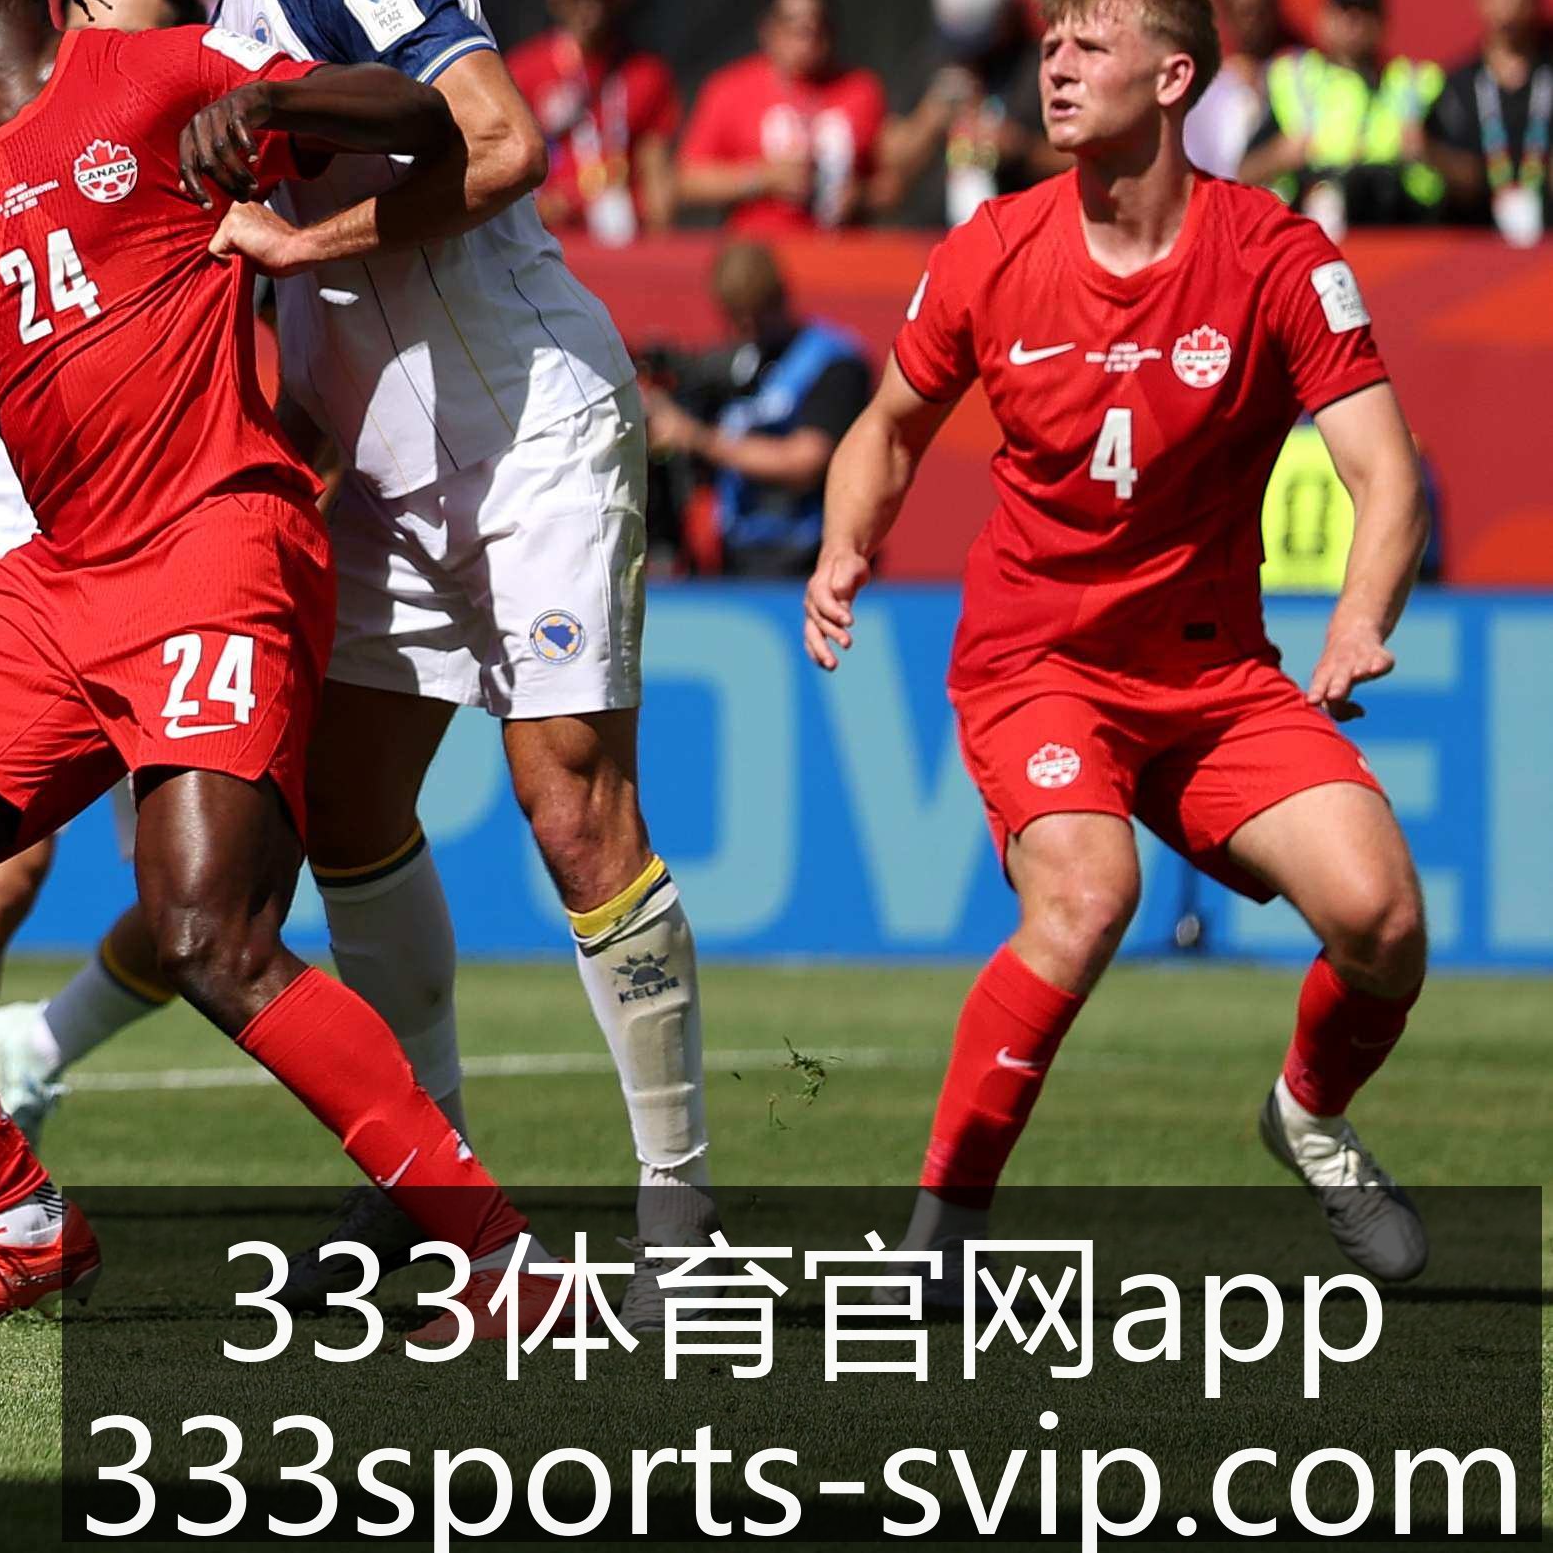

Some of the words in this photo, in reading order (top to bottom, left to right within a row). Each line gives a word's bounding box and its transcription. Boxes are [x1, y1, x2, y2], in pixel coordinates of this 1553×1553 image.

[77, 161, 135, 183] CANADA
[1090, 407, 1139, 500] 4
[160, 632, 256, 725] 24
[618, 976, 680, 1004] KELME
